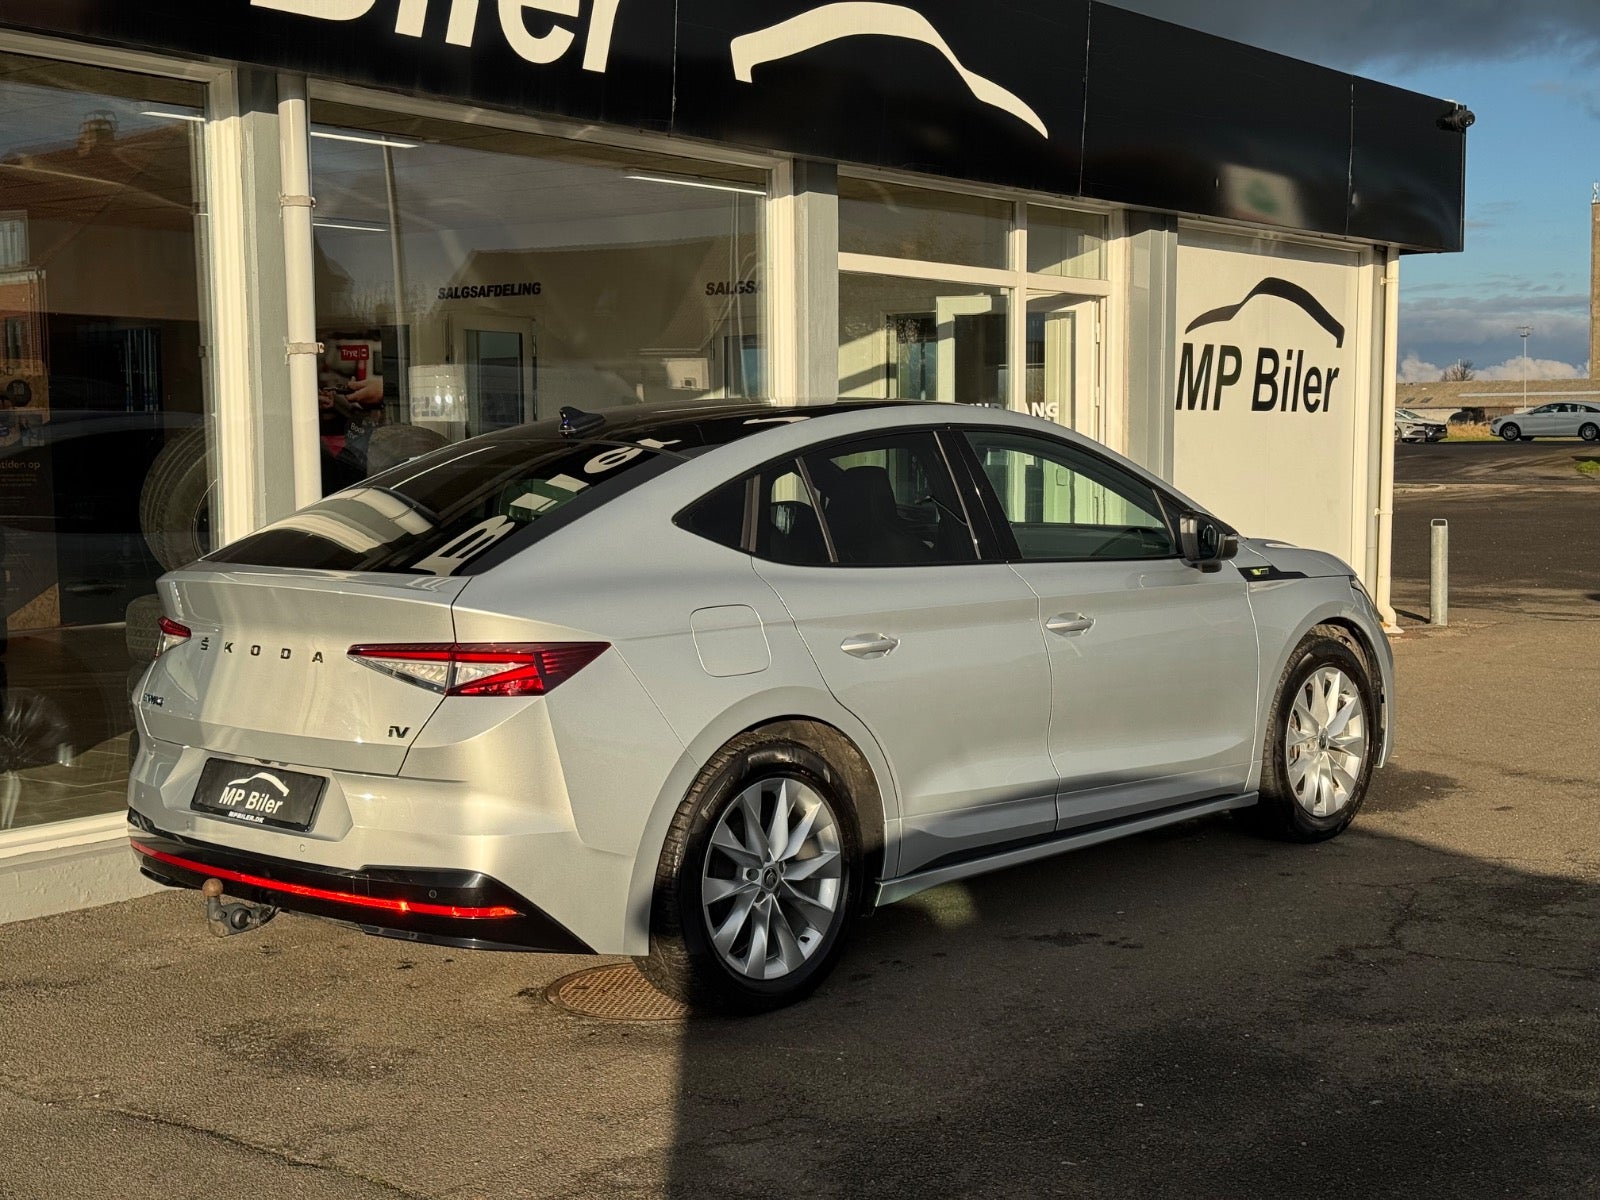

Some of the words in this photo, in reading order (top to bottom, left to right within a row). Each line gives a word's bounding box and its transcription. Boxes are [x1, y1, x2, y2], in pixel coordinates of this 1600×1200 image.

[438, 281, 541, 299] SALGSAFDELING
[704, 281, 759, 297] SALGS
[1175, 342, 1242, 411] MP
[1252, 347, 1339, 414] Biler
[219, 789, 246, 808] MP
[246, 793, 283, 815] Biler
